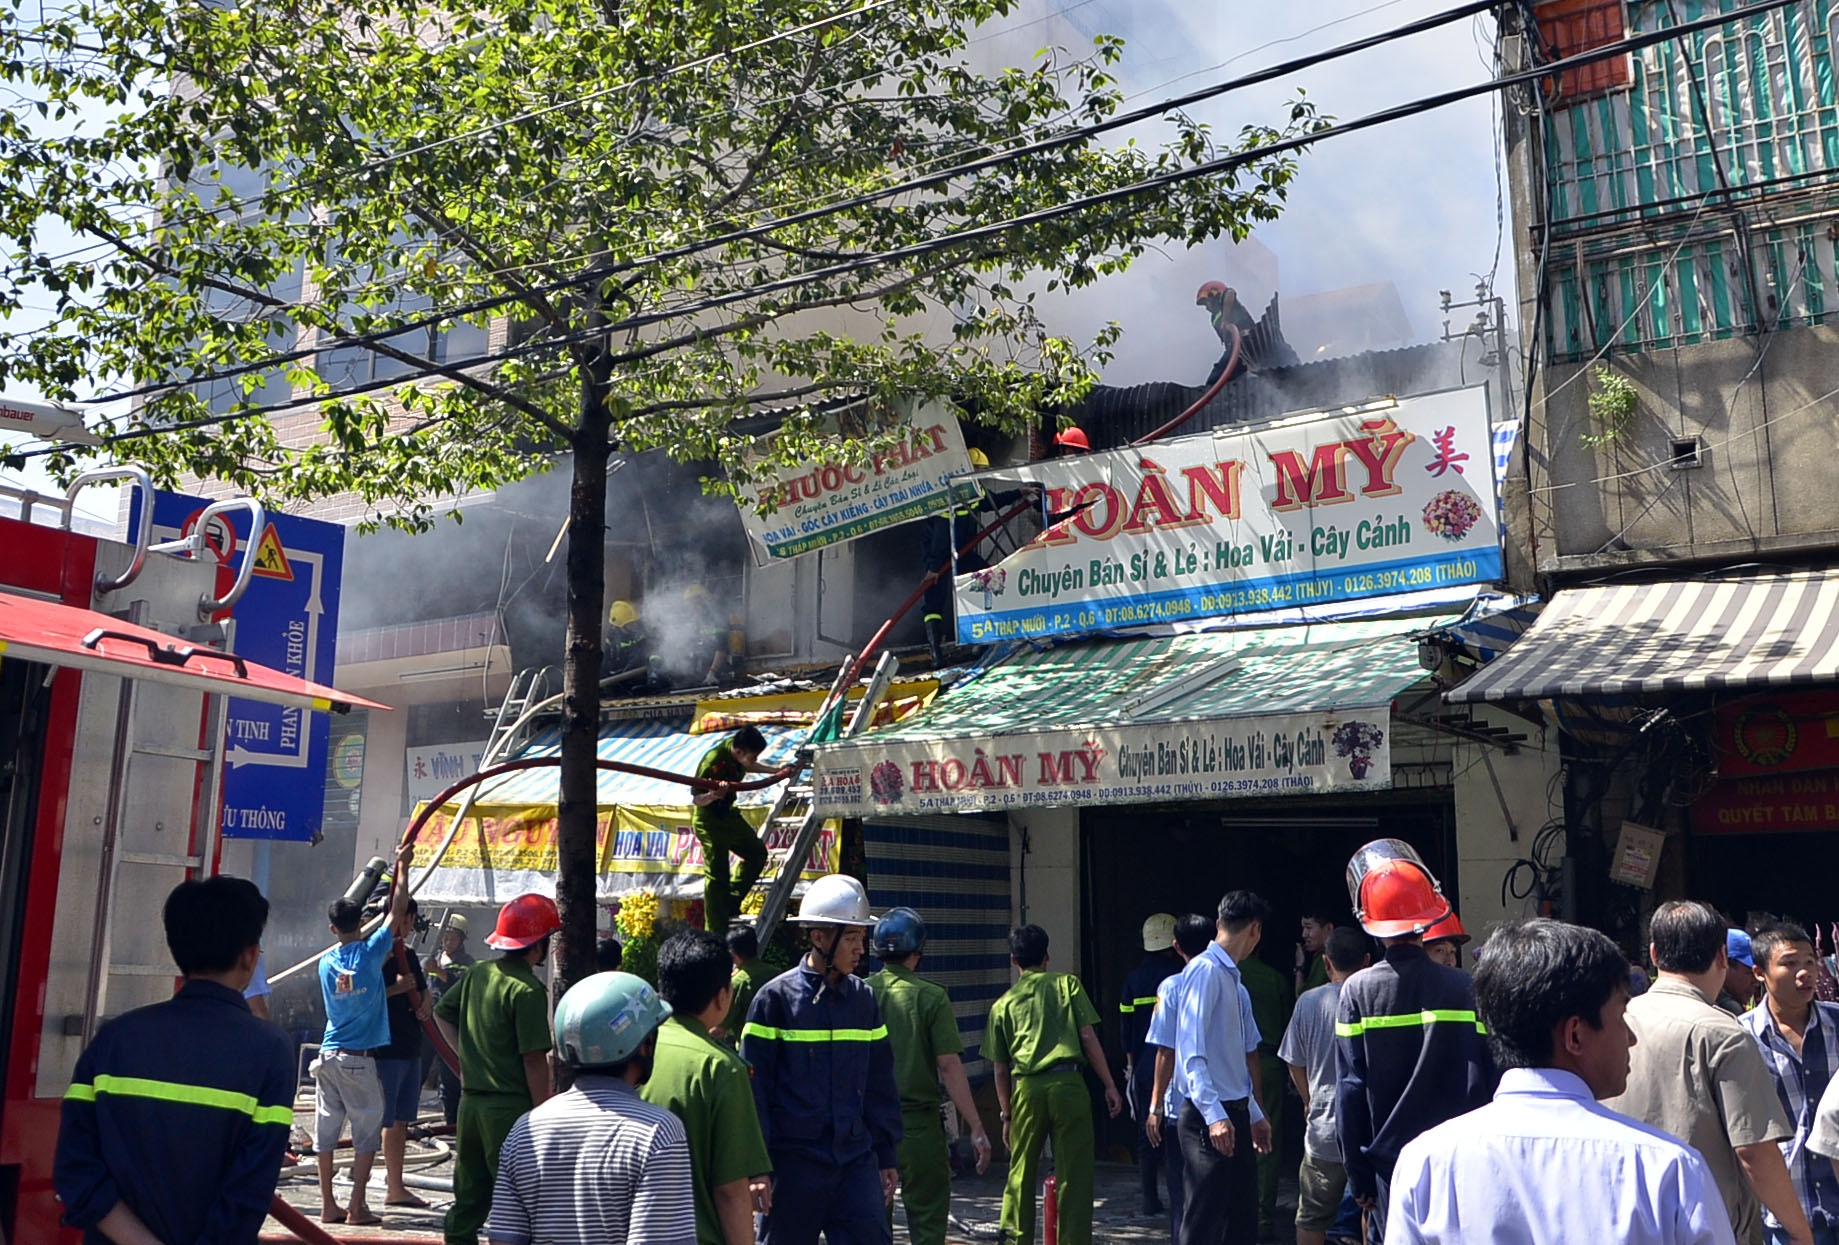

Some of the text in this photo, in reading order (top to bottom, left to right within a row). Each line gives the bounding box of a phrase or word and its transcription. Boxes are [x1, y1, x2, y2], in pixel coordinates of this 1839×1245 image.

[1268, 417, 1415, 513] MỸ
[1424, 425, 1470, 479] 美
[801, 514, 820, 533] GỐC
[821, 510, 839, 527] CÂY
[873, 493, 889, 510] CÂY
[1018, 563, 1084, 598] Chuyên
[1089, 556, 1125, 588] Bán
[1130, 550, 1148, 582] Sỉ
[1153, 551, 1168, 579] &
[1174, 542, 1198, 576] Lẻ
[1215, 540, 1254, 570] Hoa
[1260, 529, 1293, 563] Vải
[1310, 526, 1351, 560] Cây
[1356, 514, 1411, 551] Cảnh
[994, 616, 1023, 637] THÁP
[1054, 614, 1071, 629] P.2
[1079, 610, 1095, 627] Q.6
[1344, 569, 1432, 593] 0126.3974.208
[1435, 557, 1477, 583] (THẢO)
[282, 620, 305, 666] KHỎE
[235, 719, 271, 743] TỊNH
[430, 751, 465, 780] VĨNH
[910, 740, 1109, 794] HOÀN MỸ
[1118, 743, 1155, 784] Chuyên
[1157, 740, 1178, 776] Bán
[1179, 735, 1190, 775] Sỉ
[1191, 740, 1200, 774] &
[1203, 734, 1216, 773] Lẻ
[1224, 737, 1245, 772] Hoa
[1247, 730, 1265, 770] Vải
[1273, 732, 1294, 775] Cây
[1296, 727, 1326, 767] Cảnh
[1210, 779, 1279, 793] 0126.3974.208
[241, 804, 286, 831] THÔNG
[1717, 800, 1774, 825] QUYẾT
[1780, 802, 1819, 823] TÂM
